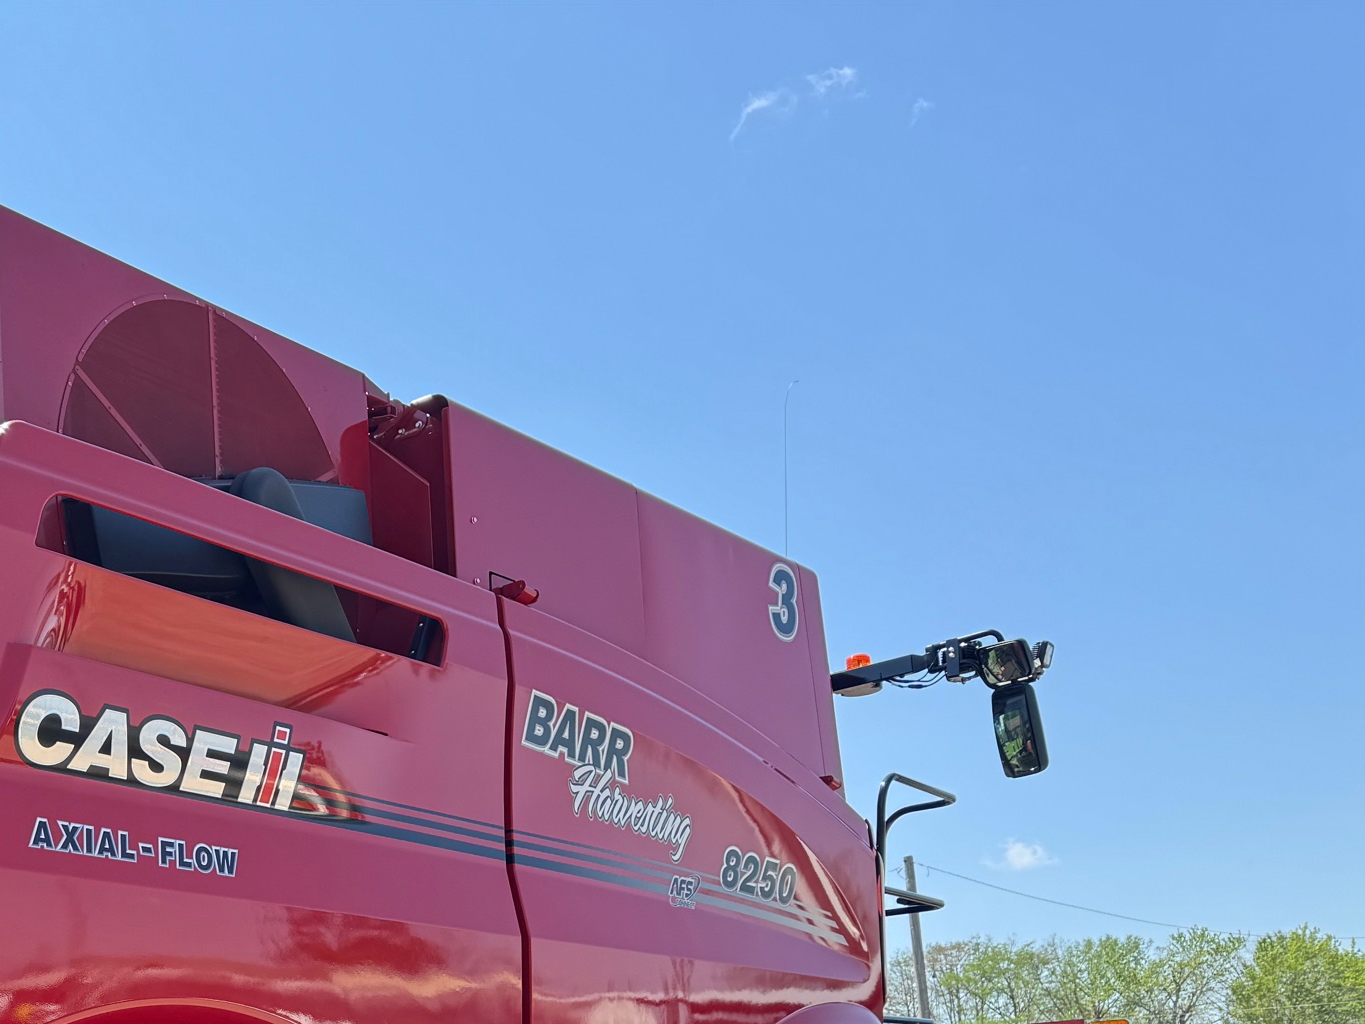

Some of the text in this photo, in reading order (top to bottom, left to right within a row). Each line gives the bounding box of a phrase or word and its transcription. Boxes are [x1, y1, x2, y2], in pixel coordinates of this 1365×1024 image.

[768, 562, 798, 641] 3
[16, 690, 239, 798] CASE
[521, 689, 633, 784] BARR
[28, 816, 239, 877] AXIAL-FLOW
[569, 763, 692, 863] Harvesting
[669, 876, 699, 900] AFS
[720, 846, 797, 906] 8250
